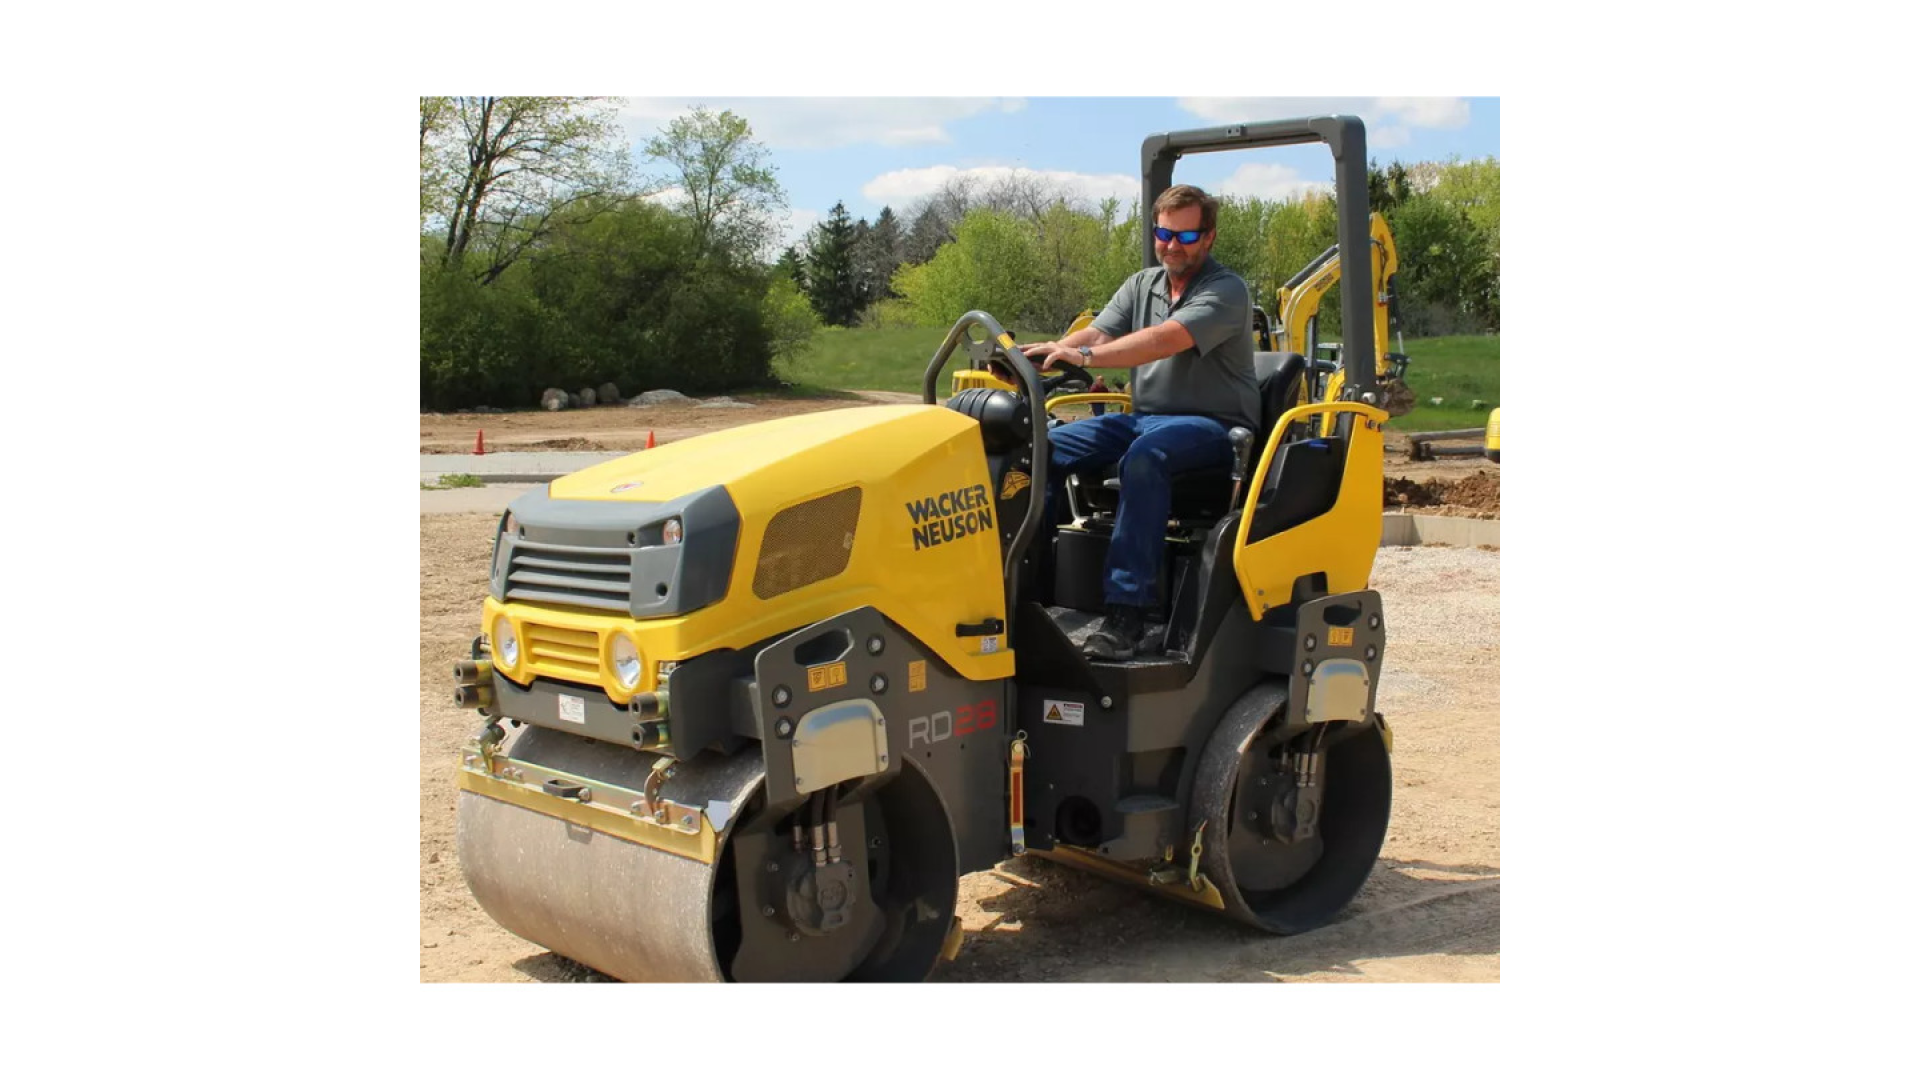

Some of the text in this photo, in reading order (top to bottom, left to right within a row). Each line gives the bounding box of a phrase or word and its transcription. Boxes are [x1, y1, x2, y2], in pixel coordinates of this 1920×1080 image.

[905, 484, 989, 524] WACKER
[912, 508, 993, 551] NEUSON
[908, 700, 996, 749] RD28
